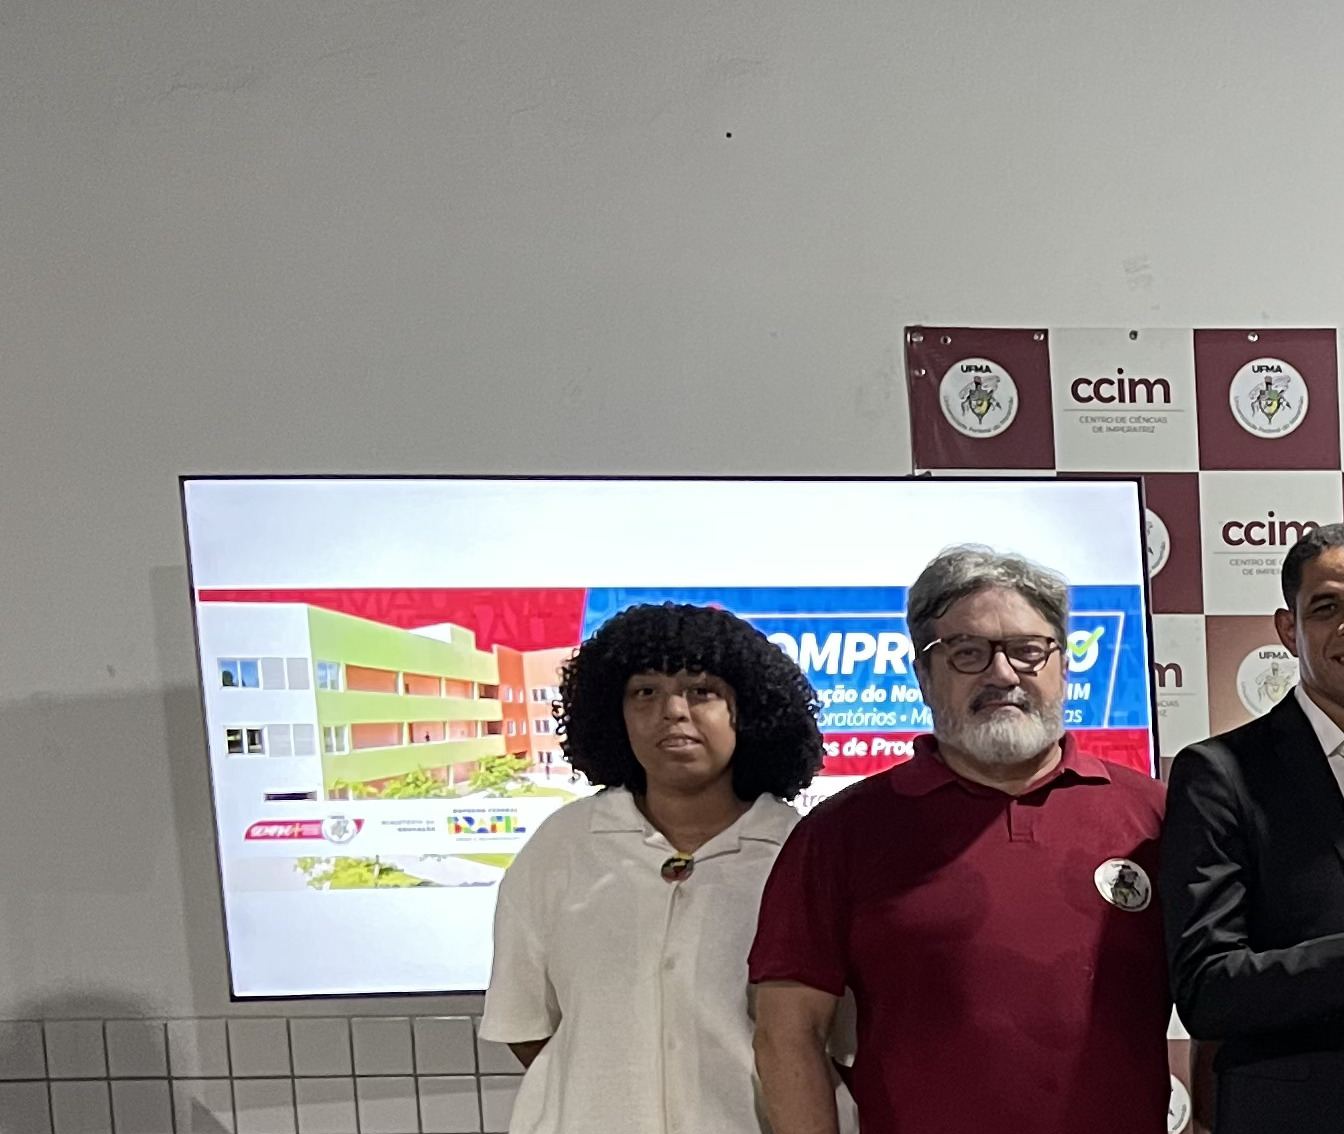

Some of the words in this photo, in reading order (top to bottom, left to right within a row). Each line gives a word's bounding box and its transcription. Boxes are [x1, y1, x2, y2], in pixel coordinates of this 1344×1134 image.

[960, 364, 992, 374] UFMA
[1251, 364, 1283, 374] UFMA
[1071, 368, 1171, 404] ccim
[1258, 651, 1289, 660] UFMA
[861, 684, 887, 703] do
[843, 737, 868, 757] de
